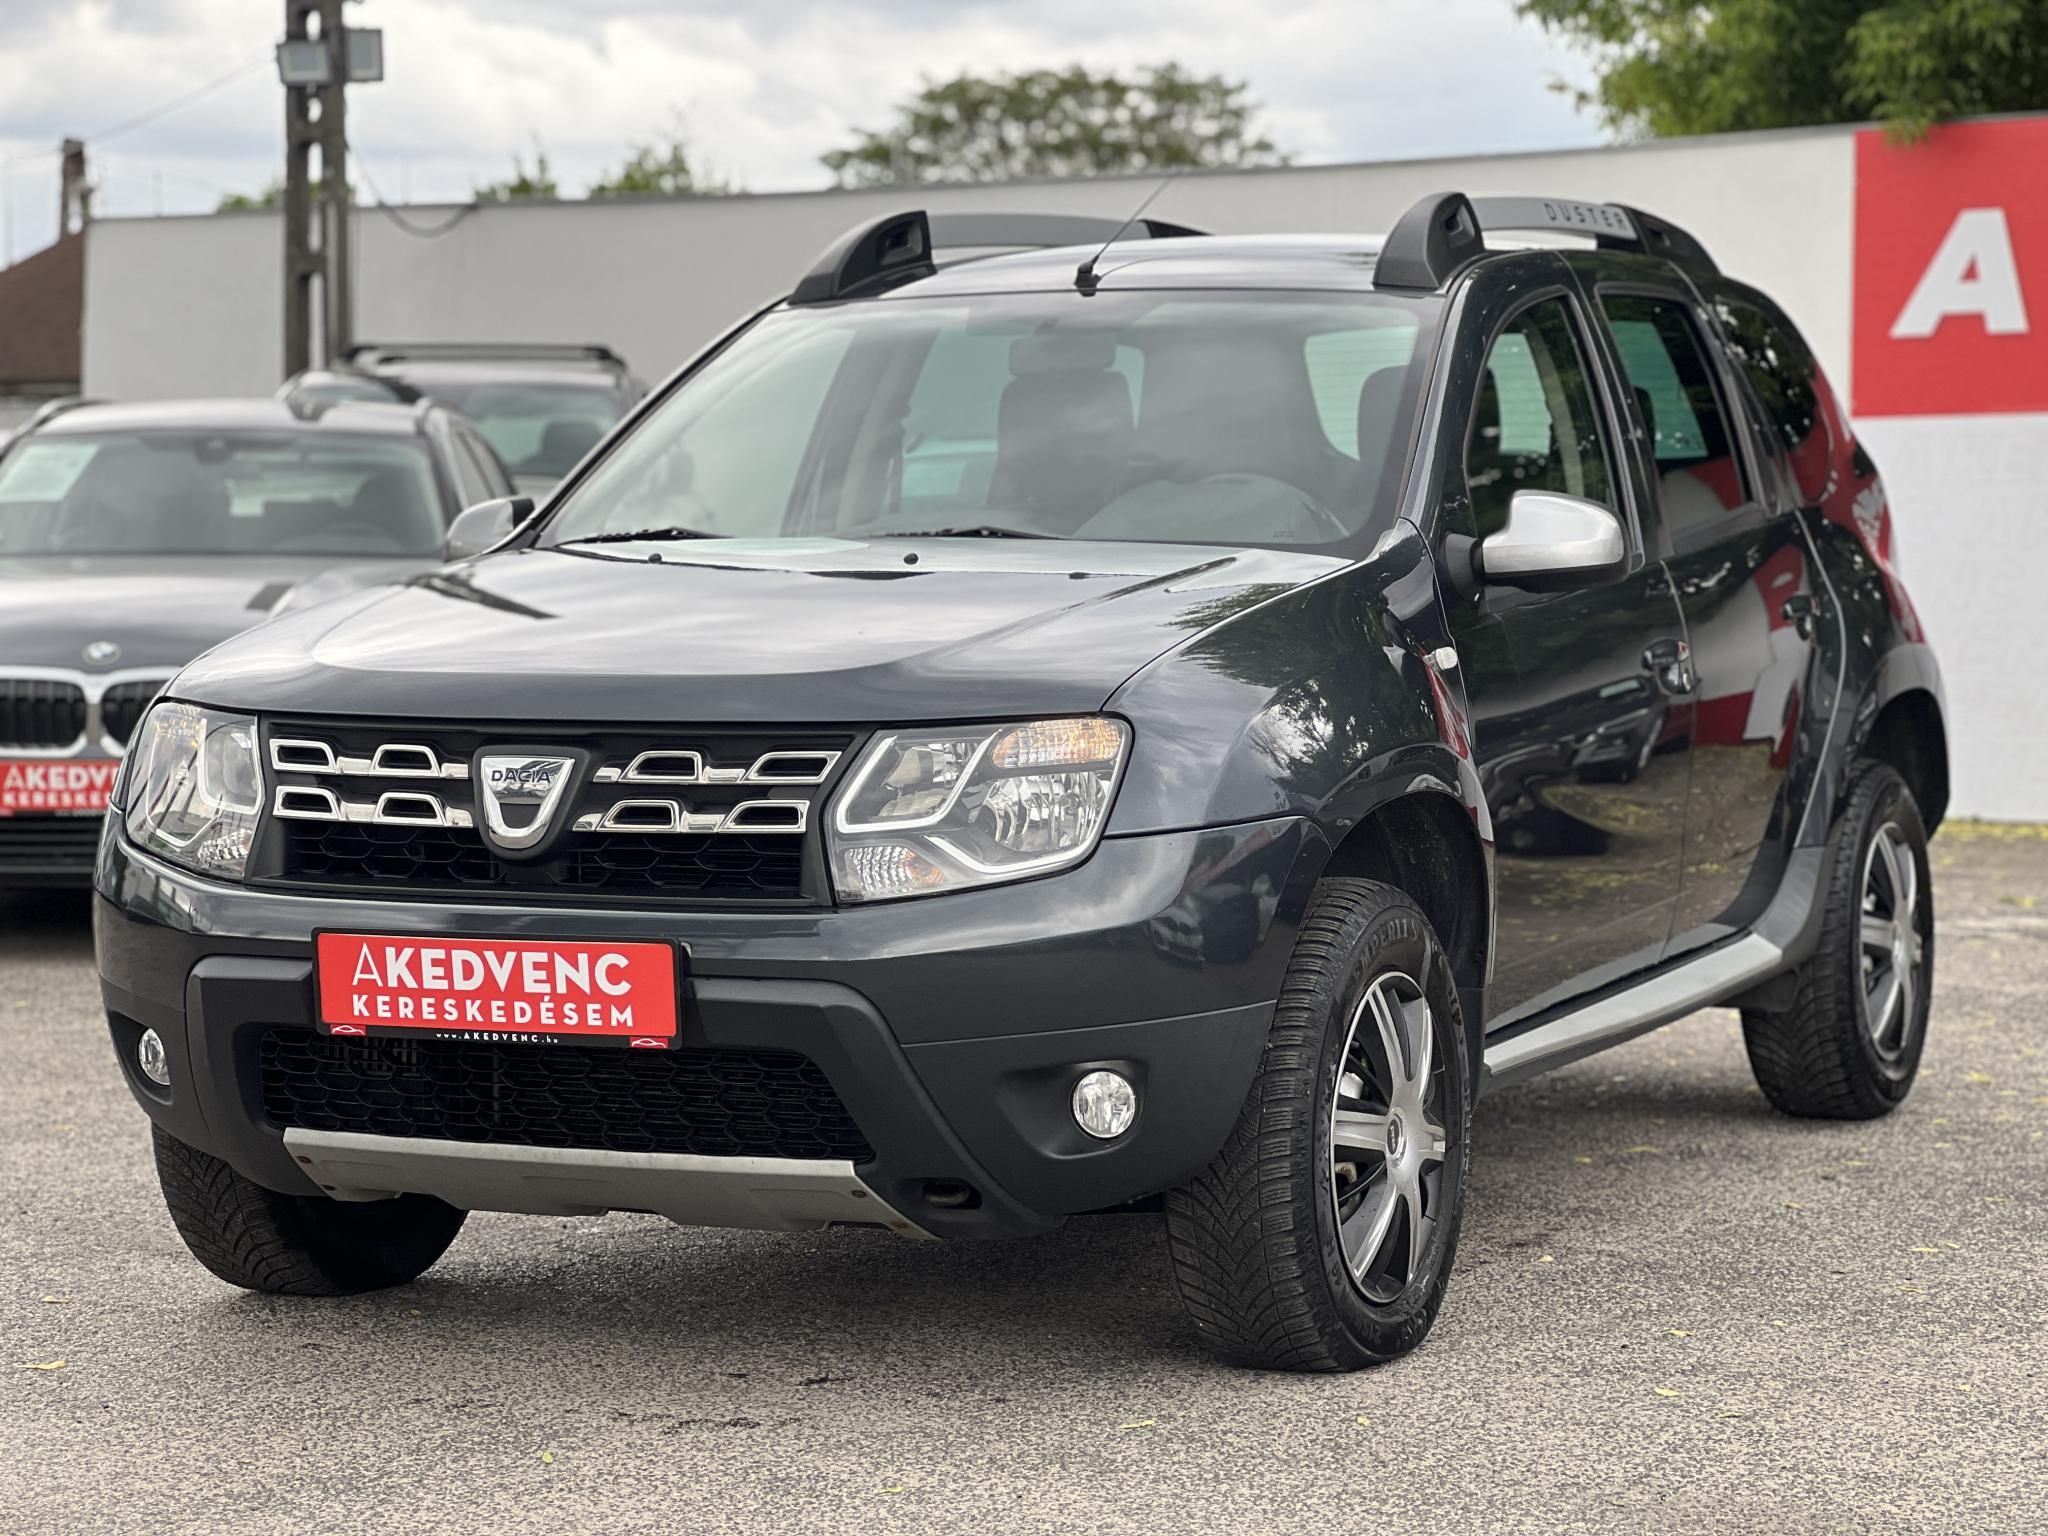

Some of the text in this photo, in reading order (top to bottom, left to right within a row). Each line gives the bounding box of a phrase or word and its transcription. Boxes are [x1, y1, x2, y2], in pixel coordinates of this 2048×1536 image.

[1544, 203, 1628, 230] DUSTER
[1889, 206, 2030, 339] A
[491, 769, 551, 783] DACIA
[351, 941, 632, 996] AKEDVENC
[352, 994, 634, 1027] KERESKEDÉSEM
